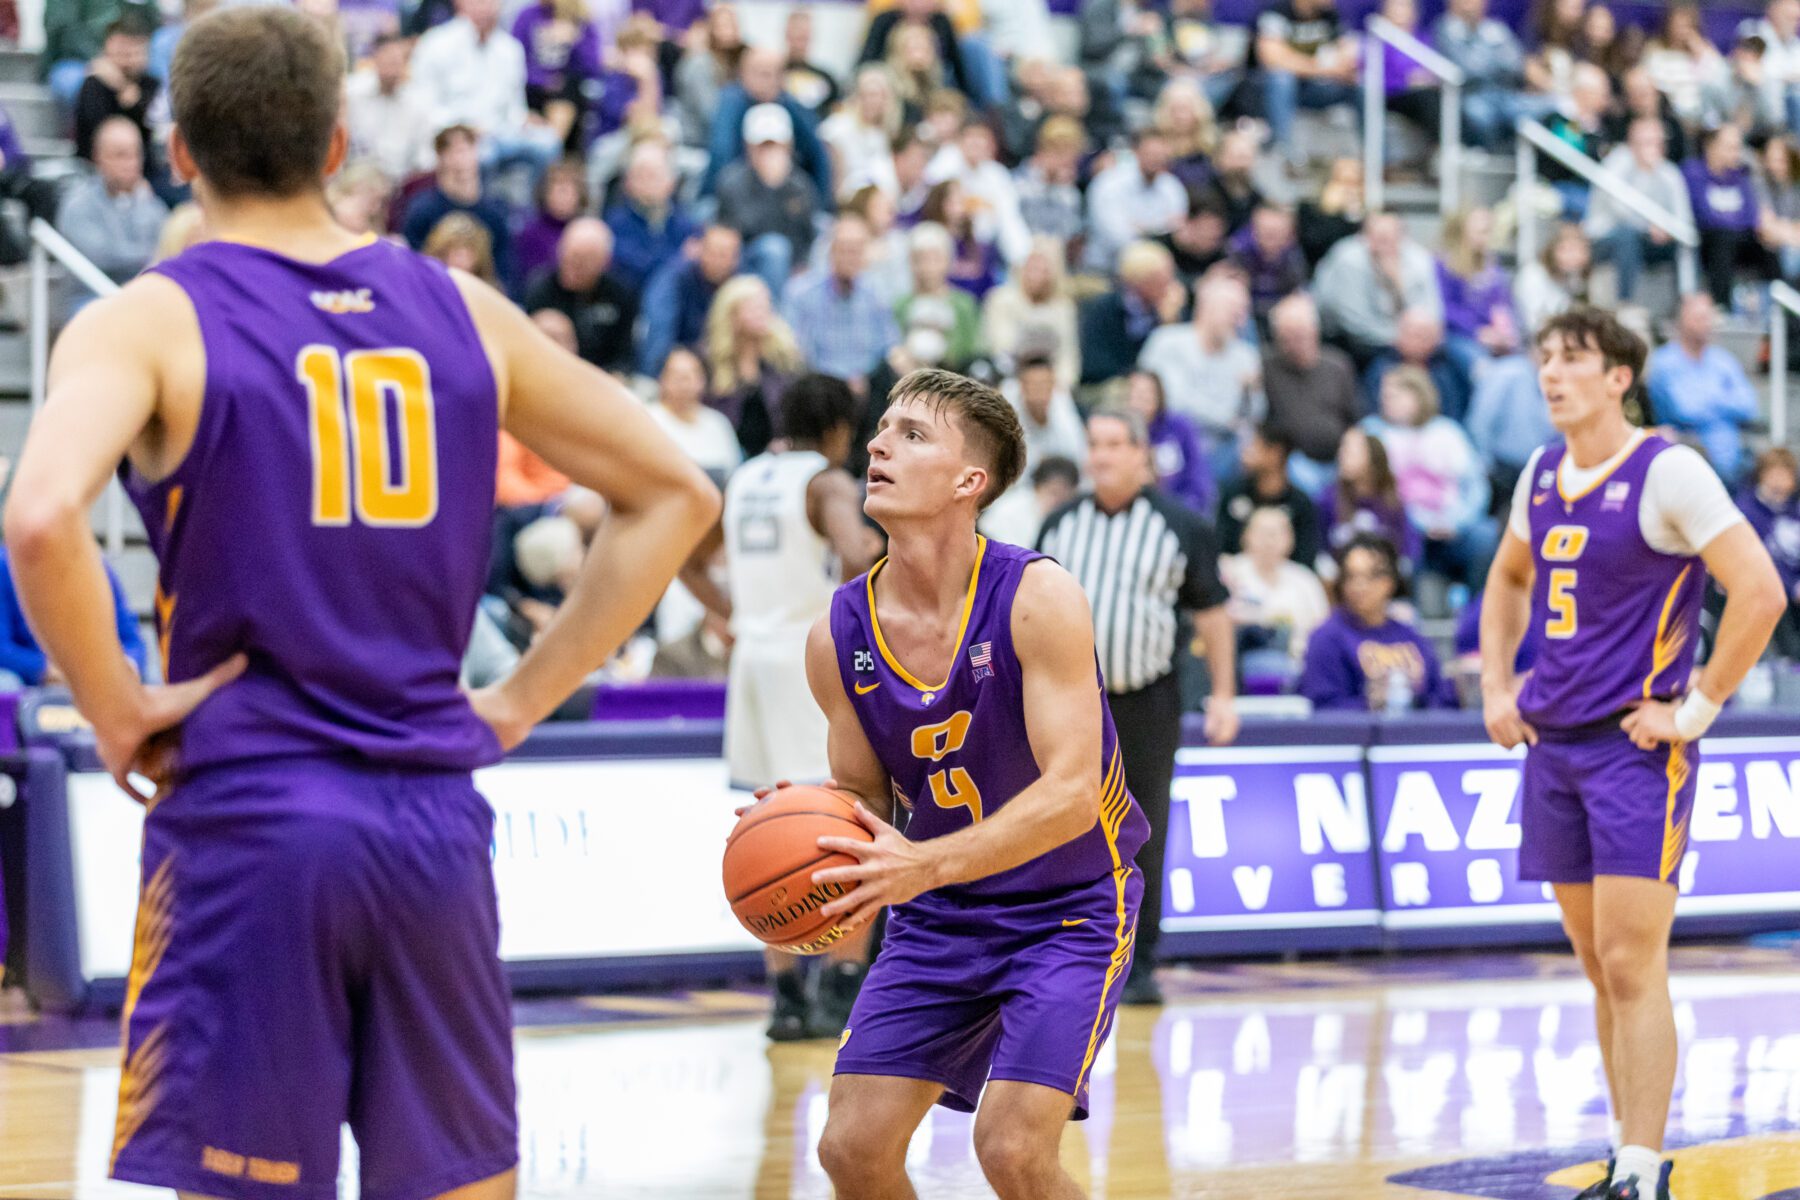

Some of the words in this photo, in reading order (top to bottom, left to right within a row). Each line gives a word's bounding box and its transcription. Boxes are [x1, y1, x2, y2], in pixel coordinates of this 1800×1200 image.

[296, 344, 439, 529] 10
[1545, 568, 1578, 640] 5
[928, 767, 983, 825] 4
[1293, 759, 1800, 855] NAZEN
